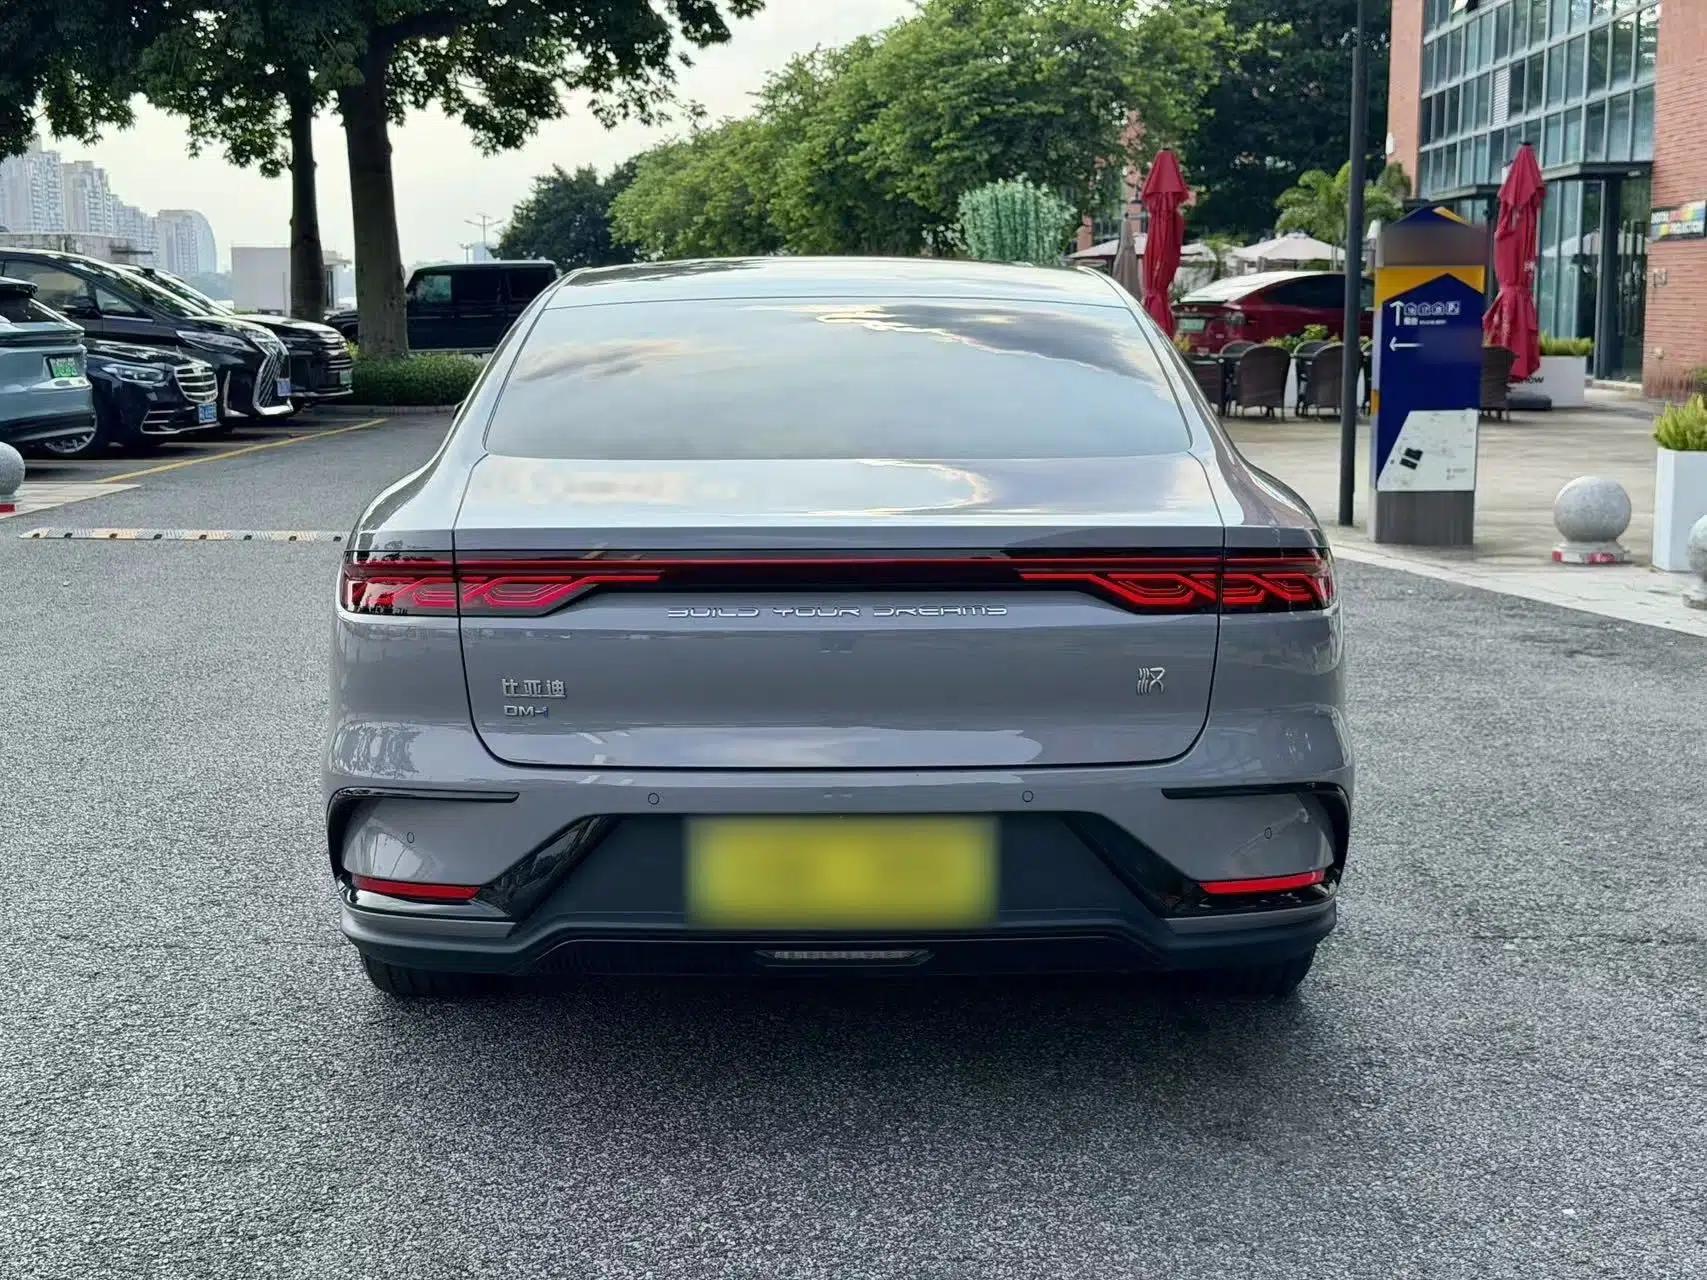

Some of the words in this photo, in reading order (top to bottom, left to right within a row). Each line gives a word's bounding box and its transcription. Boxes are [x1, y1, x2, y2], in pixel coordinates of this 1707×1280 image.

[667, 606, 760, 618] BUILD
[772, 606, 861, 618] YOUR
[873, 604, 1008, 617] DREAMS
[501, 678, 567, 699] 比亚迪
[503, 704, 549, 718] DM-i
